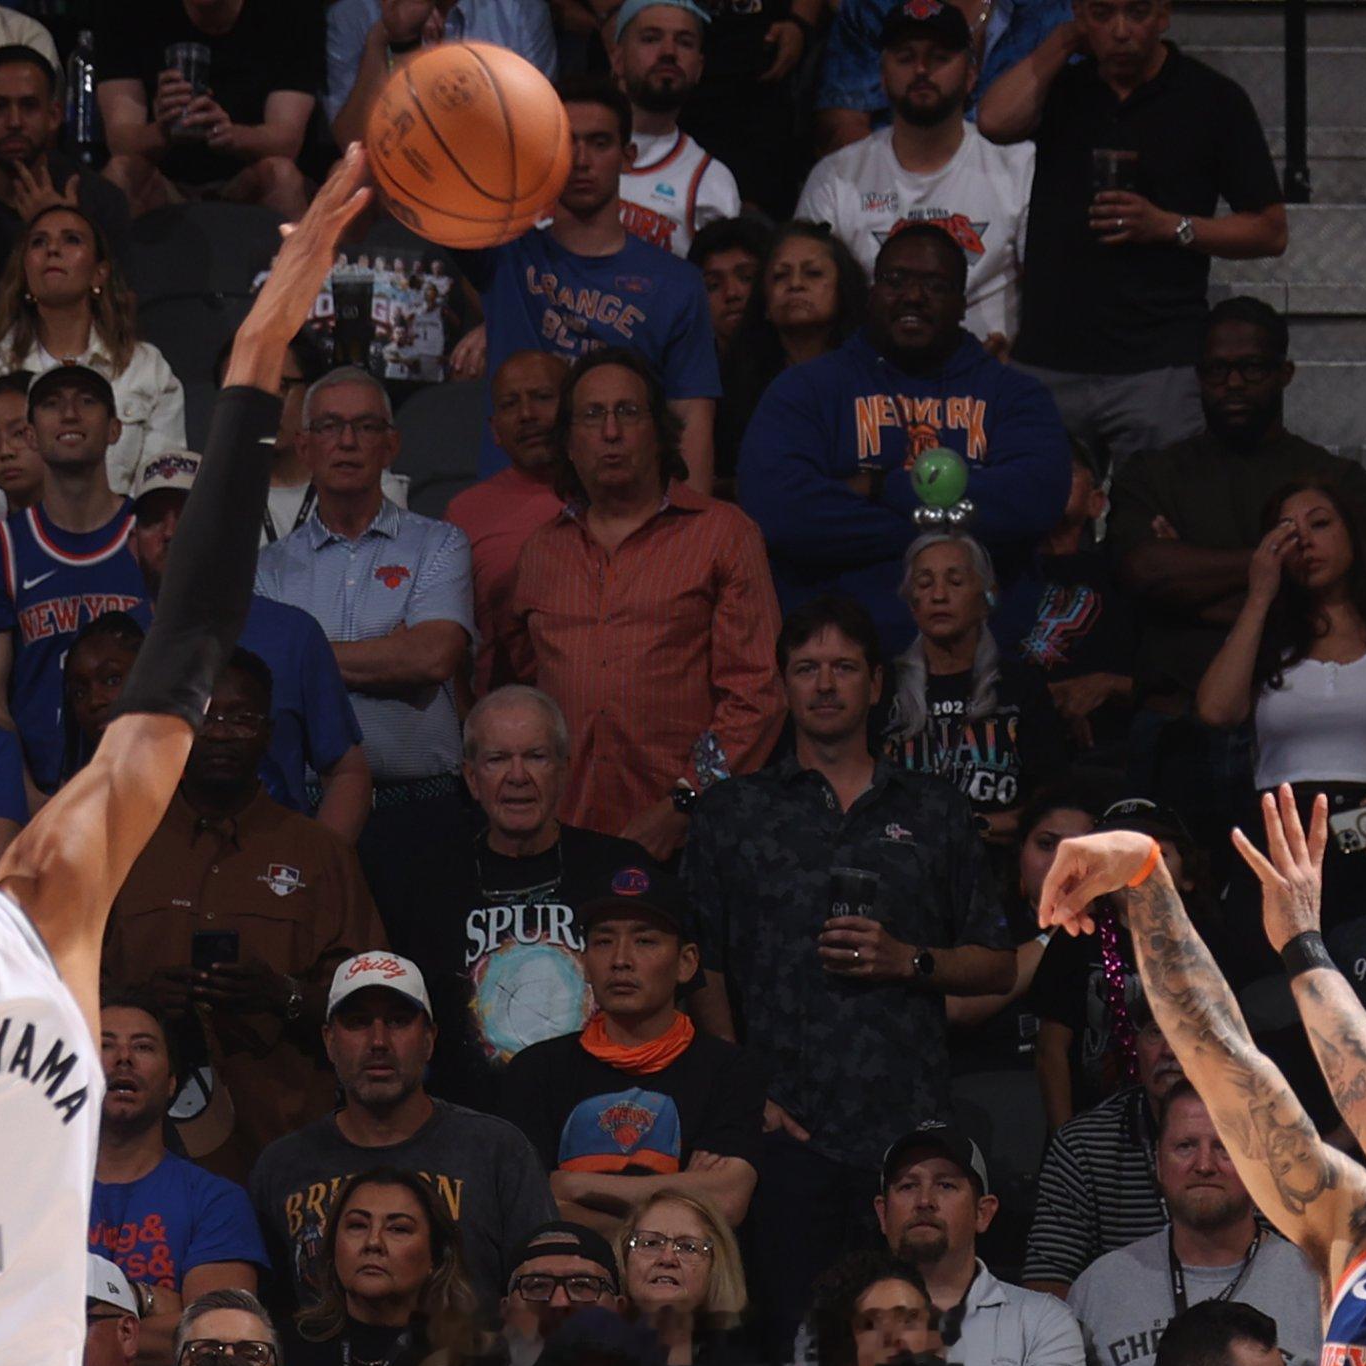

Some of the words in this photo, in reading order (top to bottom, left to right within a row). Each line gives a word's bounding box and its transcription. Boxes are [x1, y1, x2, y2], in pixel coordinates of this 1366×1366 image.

[19, 598, 80, 647] NEW
[932, 700, 966, 715] 202
[970, 770, 1018, 804] GO
[464, 902, 587, 968] SPUR
